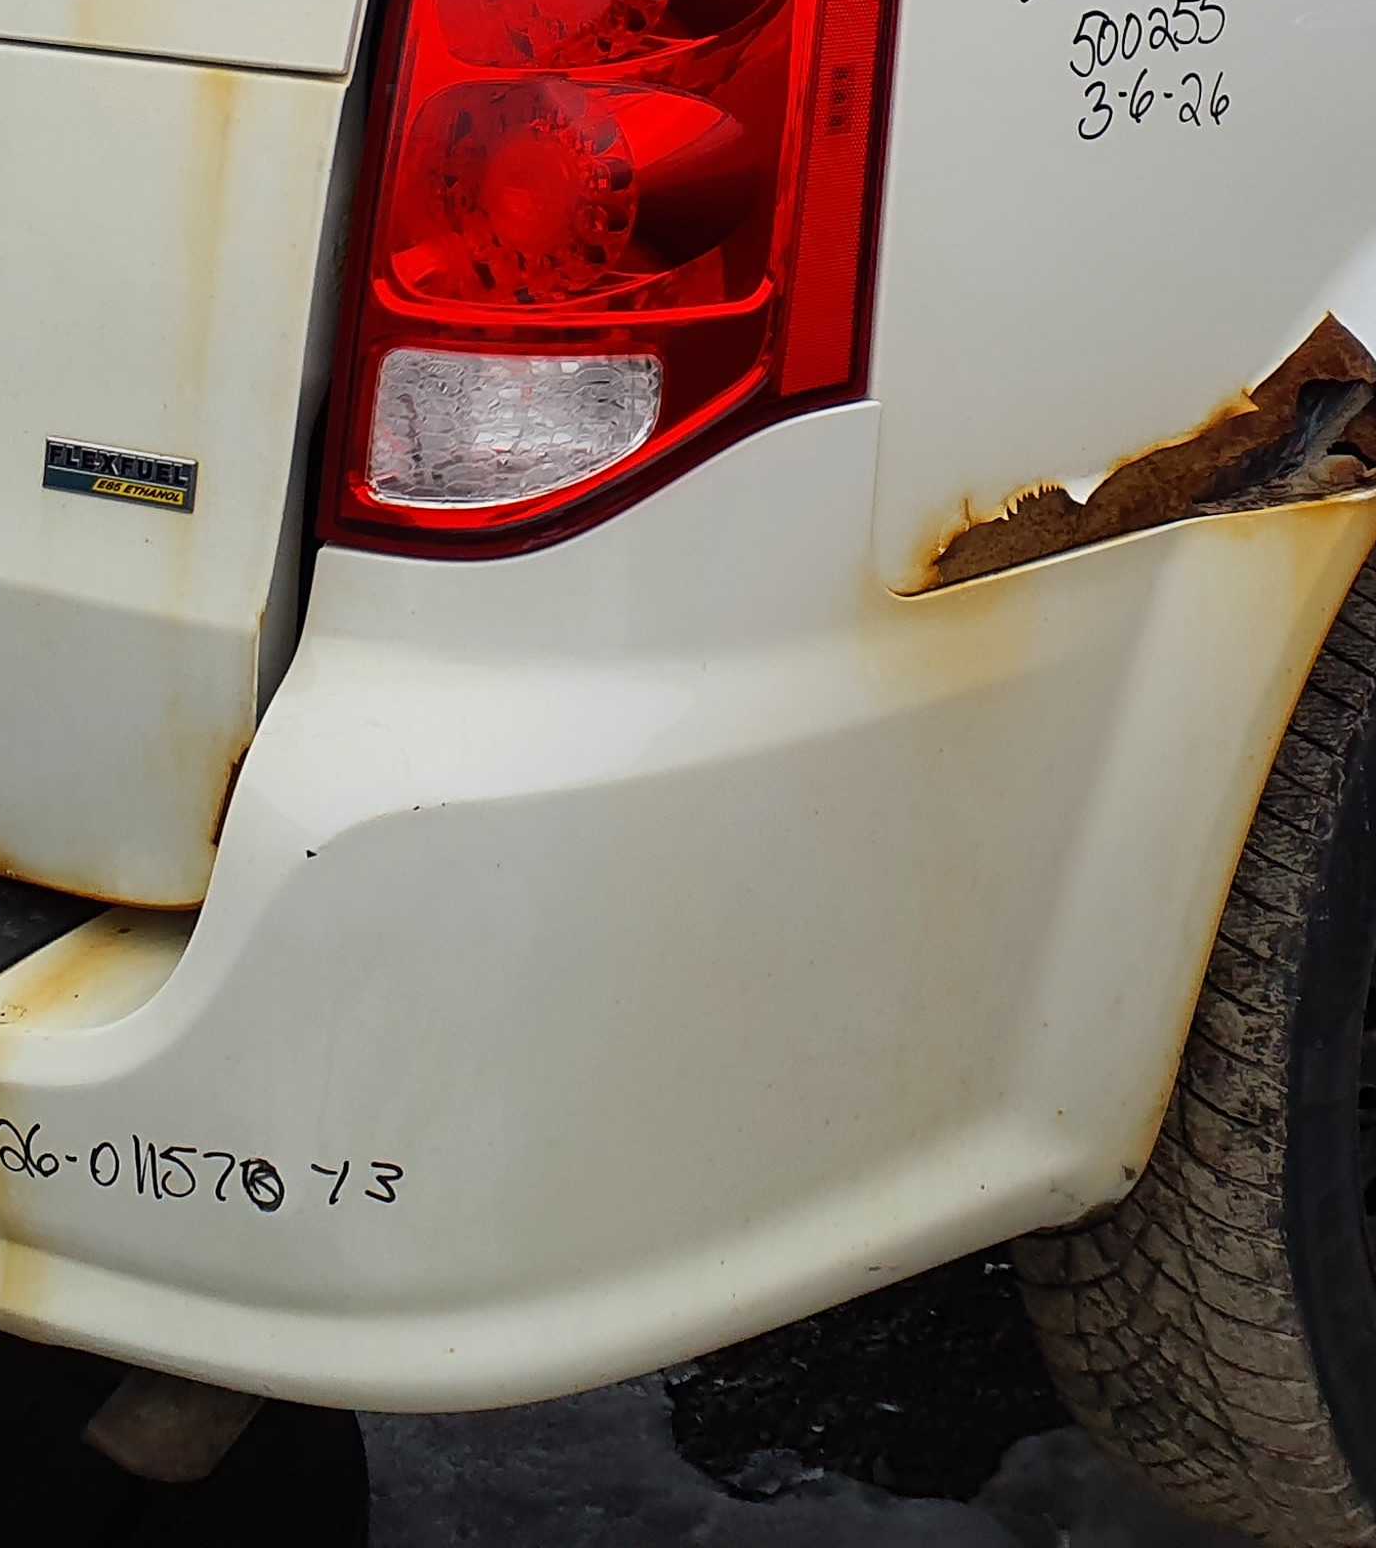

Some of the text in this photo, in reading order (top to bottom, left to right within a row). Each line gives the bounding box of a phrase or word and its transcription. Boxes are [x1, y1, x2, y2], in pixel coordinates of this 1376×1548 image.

[1077, 68, 1231, 141] 3-6-26
[97, 480, 181, 502] E85 ETHANOL
